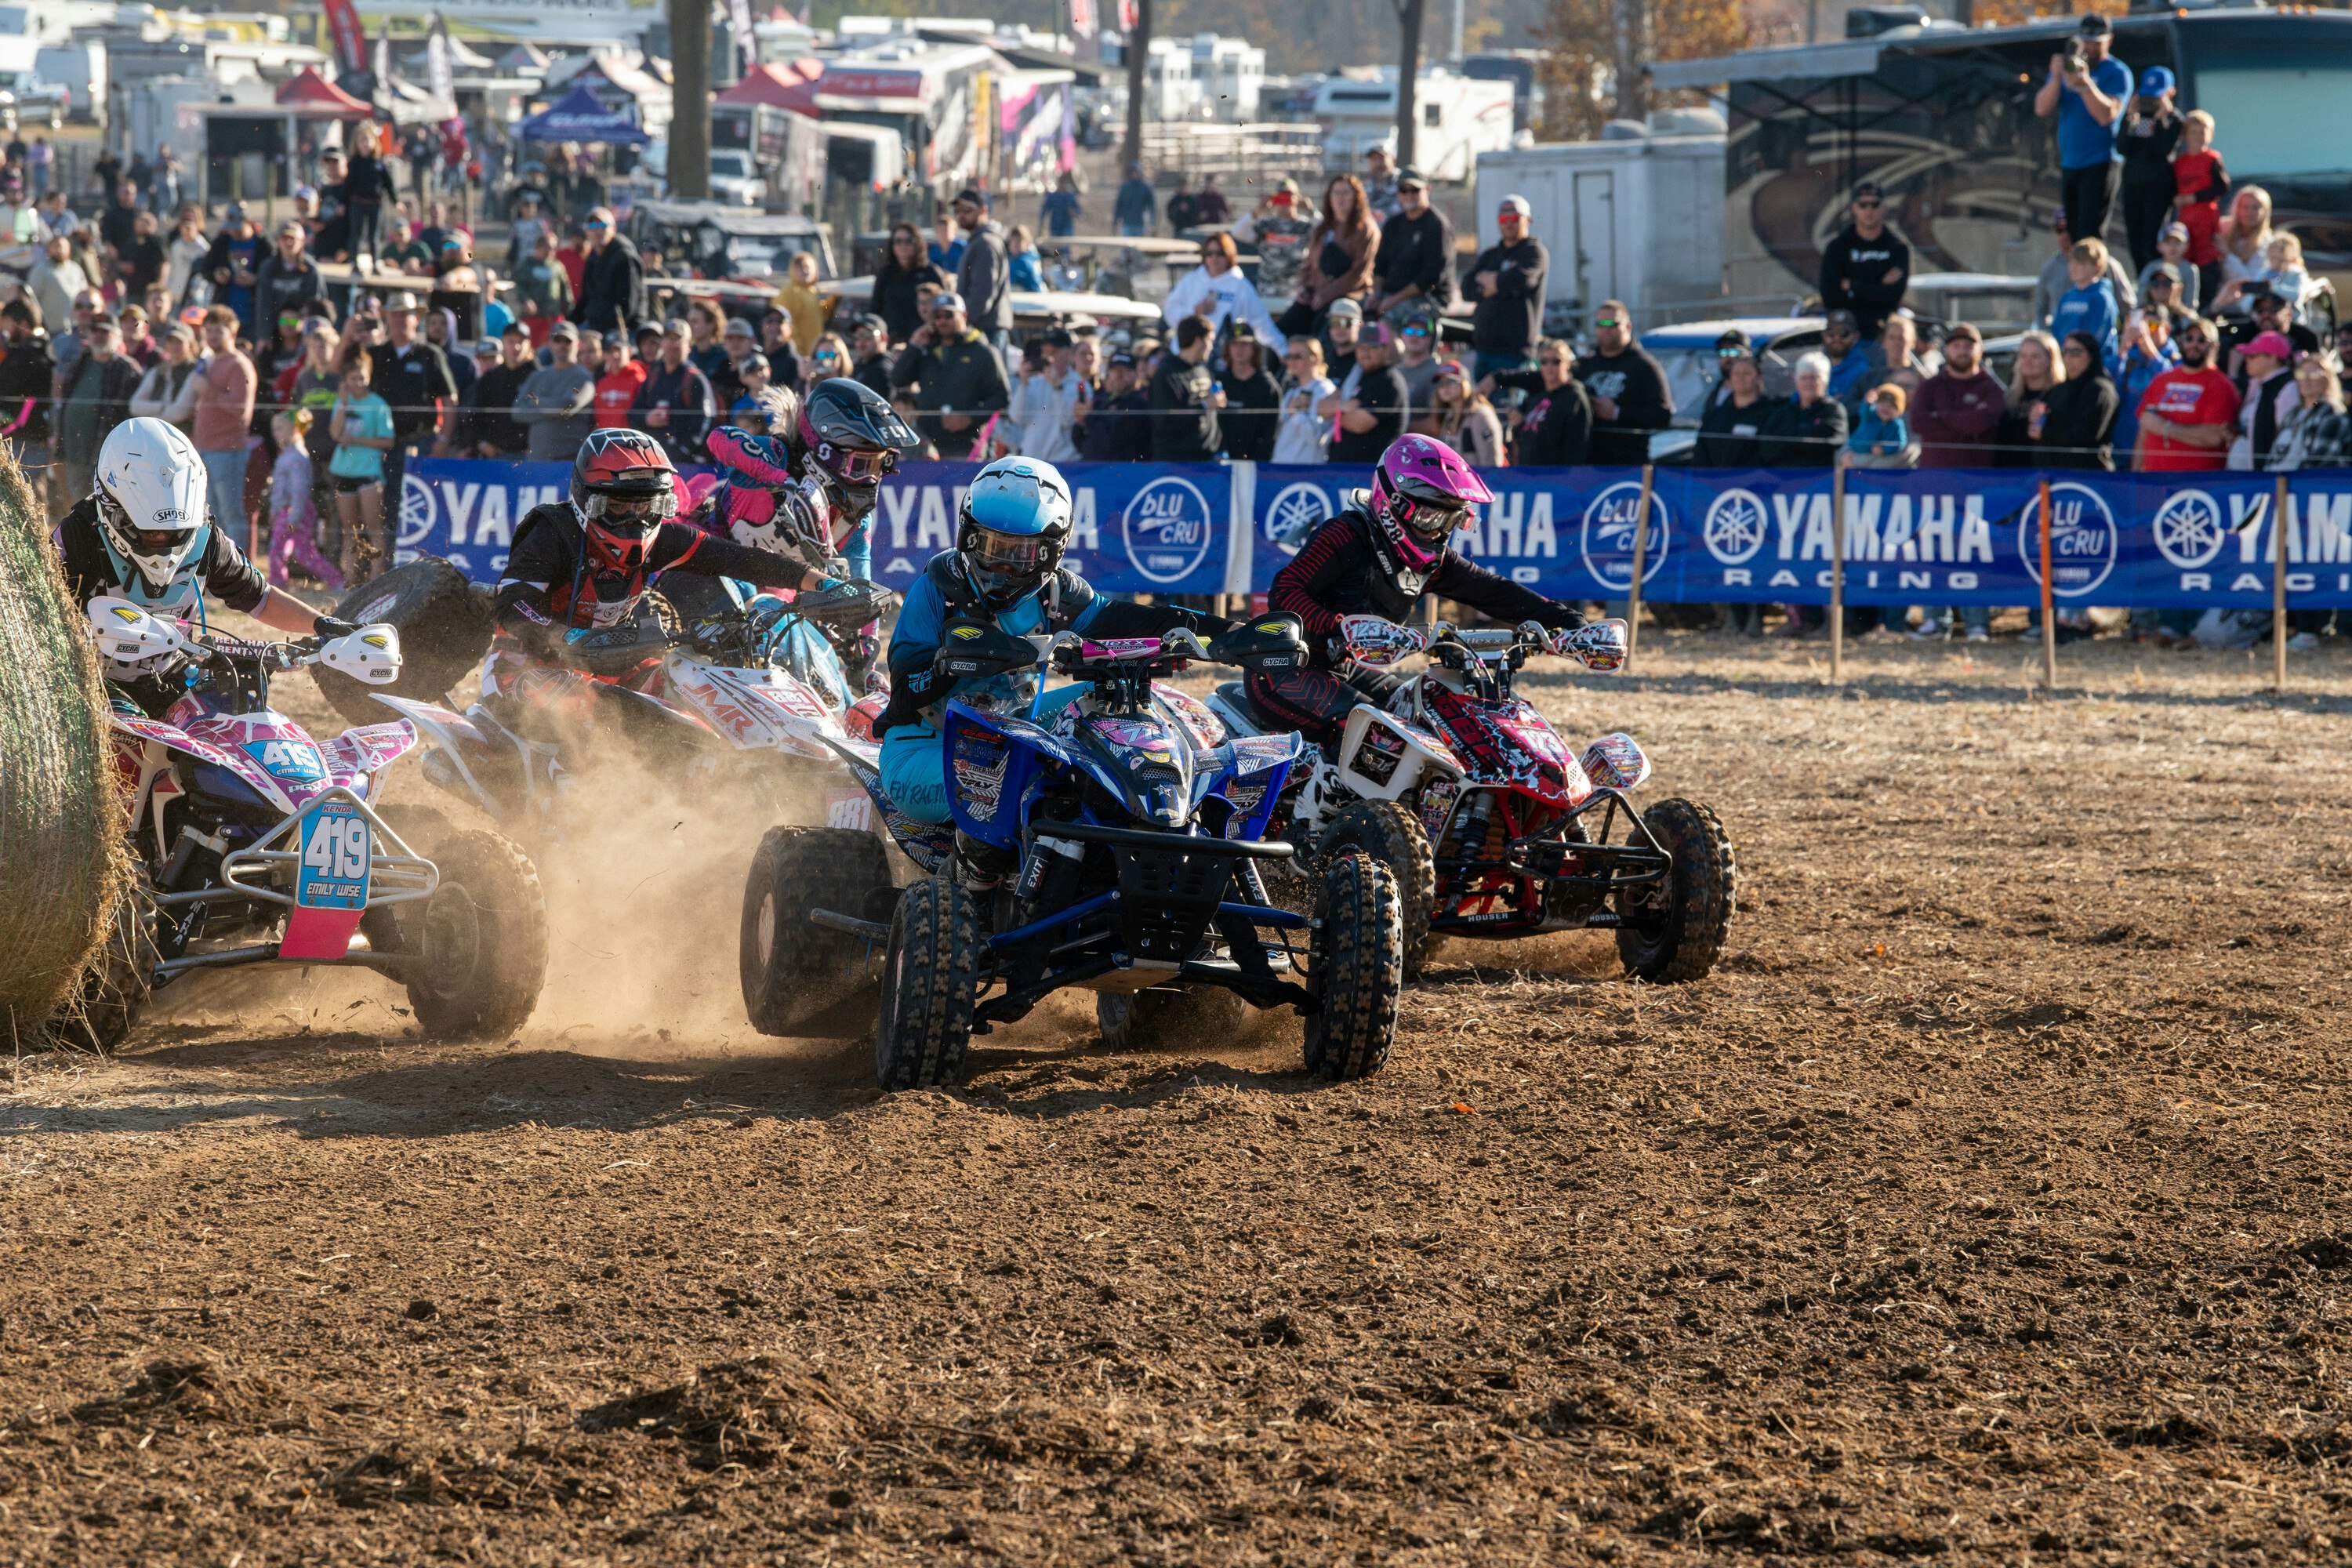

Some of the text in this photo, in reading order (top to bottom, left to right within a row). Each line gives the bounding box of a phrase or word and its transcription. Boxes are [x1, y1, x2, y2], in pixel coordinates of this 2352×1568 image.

[878, 425, 909, 440] FLY
[157, 510, 186, 521] SHOEI
[1139, 492, 1185, 517] bLU
[2043, 499, 2083, 526] LU
[1379, 506, 1406, 545] 228
[1772, 493, 1994, 563] YAMAHA
[1159, 528, 1200, 553] cRU
[2059, 529, 2106, 557] cRU
[1723, 568, 1979, 590] RACING
[1350, 621, 1382, 637] 123
[117, 644, 140, 653] CYCRA
[951, 661, 977, 671] CYCRA
[1263, 657, 1289, 666] CYCRA
[369, 668, 392, 678] CYCRA
[681, 682, 755, 736] JMR
[767, 691, 811, 705] 881
[1428, 708, 1465, 750] POWERSPORTS
[1465, 749, 1483, 769] TIRES
[262, 741, 321, 771] 419
[319, 742, 347, 775] YAMAHA
[276, 767, 301, 775] EMILY
[969, 764, 1001, 776] TIREBALLS
[288, 784, 323, 794] PGX
[889, 780, 912, 804] FLY
[909, 782, 949, 806] RACIN
[322, 804, 353, 814] KENDA
[826, 793, 873, 832] 881
[303, 815, 368, 880] 419
[1027, 858, 1044, 888] EXIT
[306, 882, 362, 898] EMILY WISE
[1245, 873, 1264, 900] EXIT
[1467, 912, 1508, 923] HOUSER
[1588, 913, 1621, 923] HOUSER
